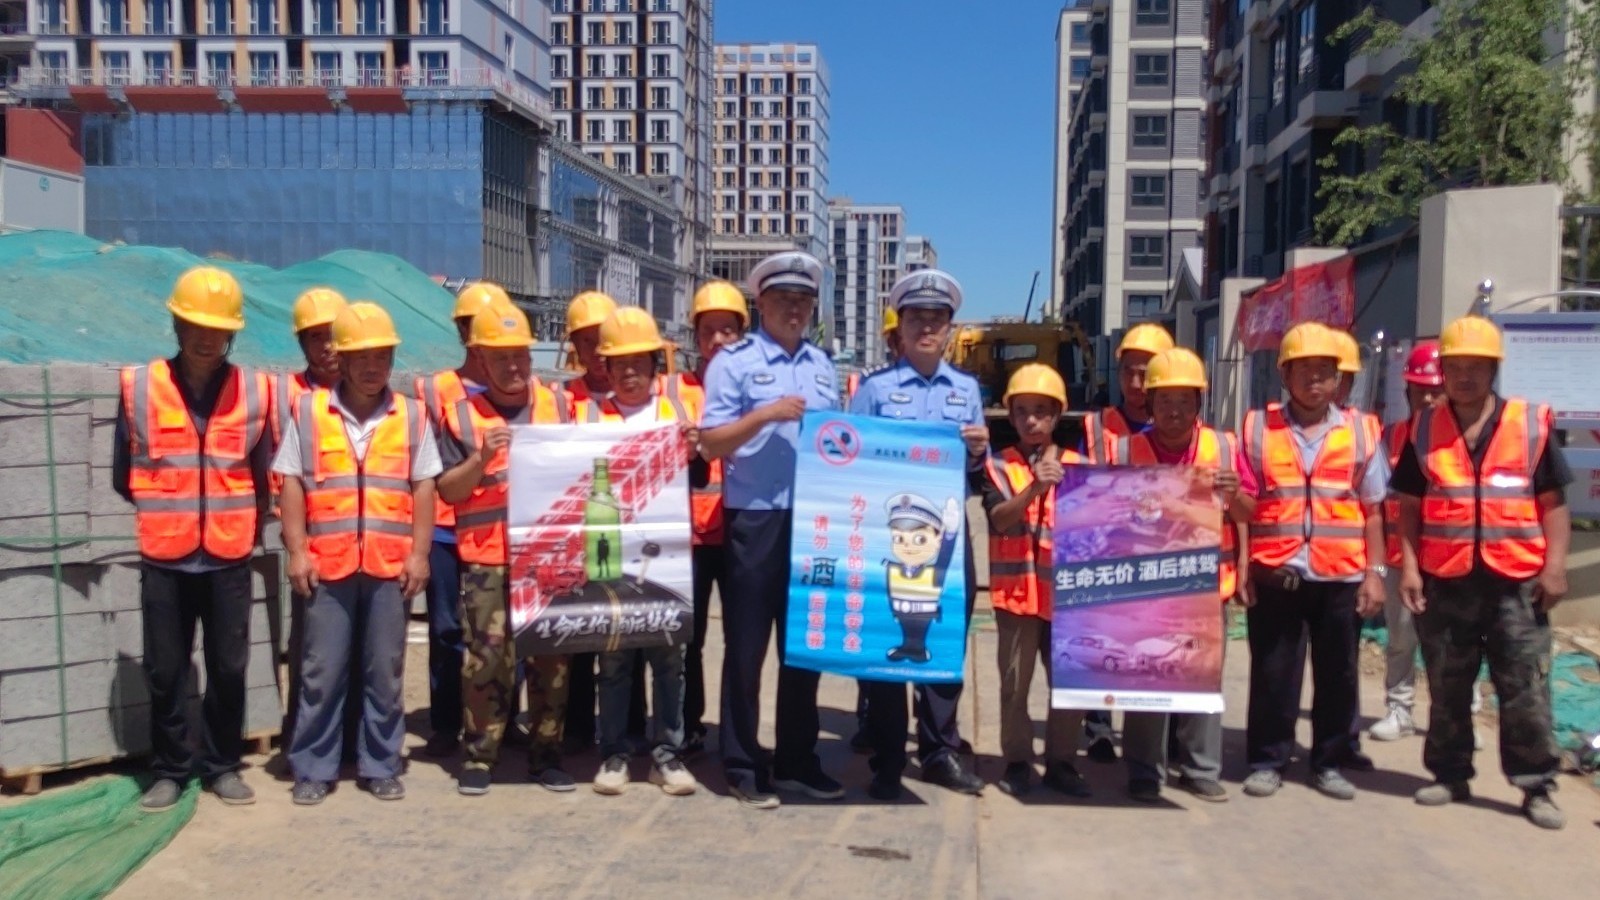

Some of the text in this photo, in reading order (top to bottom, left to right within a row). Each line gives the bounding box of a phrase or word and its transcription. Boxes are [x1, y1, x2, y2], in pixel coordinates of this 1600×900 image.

[1055, 554, 1218, 590] 生命无价 酒后禁驾
